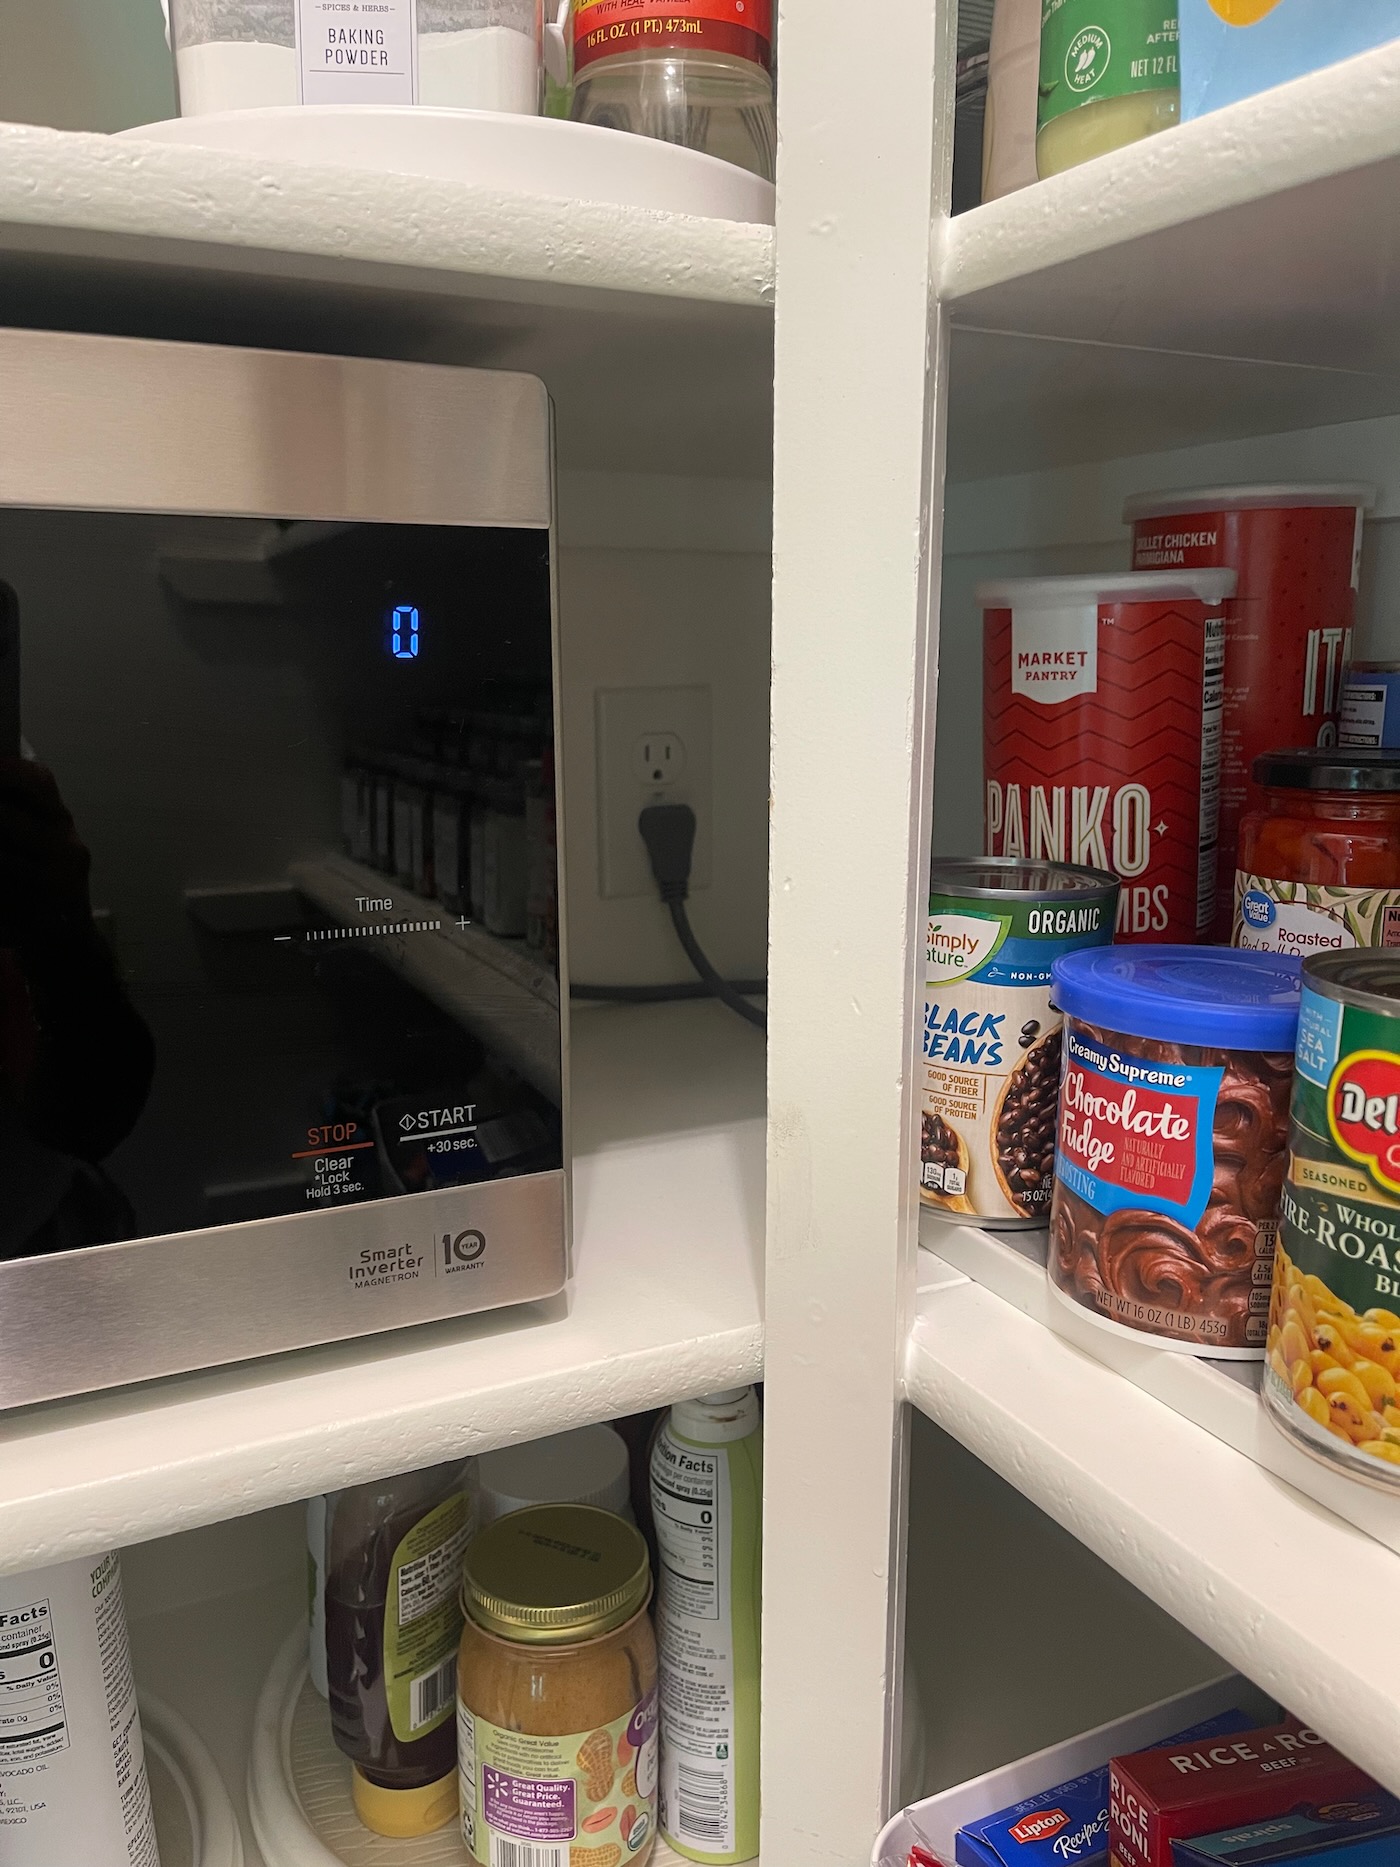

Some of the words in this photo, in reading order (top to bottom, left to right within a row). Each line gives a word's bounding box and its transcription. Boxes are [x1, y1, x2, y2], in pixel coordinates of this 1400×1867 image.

[597, 1, 617, 14] WITH
[587, 33, 597, 48] 16
[610, 24, 629, 40] OZ.
[631, 22, 641, 37] (1
[643, 18, 663, 34] PT.)
[665, 18, 703, 34] 473mL
[1163, 19, 1181, 30] RE
[328, 28, 384, 45] BAKING
[1071, 33, 1104, 58] MEDIUM
[325, 48, 389, 66] POWDER
[1130, 58, 1149, 78] NET
[1152, 56, 1164, 75] 12
[1166, 55, 1178, 73] FL
[1073, 68, 1096, 85] HEAT
[1164, 531, 1218, 549] CHICKEN
[392, 605, 419, 659] 0
[1018, 651, 1088, 669] MARKET
[1025, 671, 1078, 681] PANTRY
[987, 779, 1151, 878] PANKO
[355, 896, 393, 913] Time
[1244, 896, 1270, 915] Great
[1028, 907, 1101, 934] ORGANIC
[1247, 911, 1270, 923] Value
[1278, 928, 1343, 949] Roasted
[1010, 972, 1053, 981] NON-GM
[1301, 1028, 1325, 1054] SEA
[1069, 1035, 1109, 1072] Creamy
[1108, 1053, 1186, 1088] Supreme
[1298, 1043, 1328, 1071] SALT
[928, 1069, 947, 1081] GOOD
[949, 1074, 979, 1087] SOURCE
[942, 1083, 953, 1093] OF
[954, 1084, 978, 1097] FIBER
[929, 1094, 947, 1106] GOOD
[948, 1098, 977, 1111] SOURCE
[1065, 1071, 1191, 1141] Chocolate
[1339, 1081, 1399, 1136] Del
[417, 1104, 477, 1129] START
[934, 1105, 944, 1114] OF
[944, 1108, 977, 1120] PROTEIN
[308, 1122, 358, 1146] STOP
[1062, 1110, 1115, 1172] Fudge
[427, 1140, 451, 1154] +30
[452, 1137, 479, 1151] sec.
[1123, 1136, 1166, 1160] NATURALLY
[314, 1156, 355, 1174] Clear
[1121, 1151, 1135, 1168] AND
[1135, 1157, 1187, 1180] ARTIFICIALLY
[1119, 1165, 1156, 1189] FLAVORED
[1302, 1167, 1368, 1193] SEASONED
[306, 1187, 332, 1200] Hold
[333, 1184, 341, 1196] 3
[342, 1181, 365, 1194] sec.
[1021, 1190, 1033, 1202] 15
[1335, 1202, 1400, 1242] WHOL
[359, 1243, 413, 1264] Smart
[441, 1229, 486, 1265] 10
[460, 1242, 478, 1250] YEAR
[348, 1255, 425, 1280] Inverter
[444, 1261, 486, 1275] WARRANTY
[354, 1270, 420, 1290] MAGNETRON
[1096, 1289, 1113, 1308] NET
[1116, 1298, 1131, 1315] WT
[1134, 1304, 1144, 1320] 16
[1147, 1308, 1162, 1324] OZ
[1165, 1311, 1174, 1327] (1
[1177, 1317, 1196, 1332] LB)
[1199, 1319, 1227, 1337] 453g
[678, 1455, 714, 1473] Facts
[683, 1475, 713, 1486] container
[700, 1510, 713, 1525] 0
[90, 1555, 110, 1585] YOUR
[0, 1606, 48, 1628] Facts
[1, 1624, 43, 1642] container
[12, 1639, 30, 1649] spray
[39, 1651, 55, 1669] 0
[16, 1681, 35, 1690] Daily
[46, 1681, 59, 1691] 0%
[47, 1692, 61, 1702] 0%
[49, 1702, 63, 1713] 0%
[17, 1715, 28, 1723] 0g
[492, 1729, 517, 1743] Organic
[518, 1737, 537, 1747] Great
[539, 1740, 559, 1748] Value
[1168, 1742, 1260, 1774] RICE
[1262, 1741, 1277, 1752] A
[1274, 1728, 1327, 1752] RO
[1259, 1756, 1298, 1773] BEEF
[512, 1780, 535, 1791] Great
[536, 1783, 571, 1793] Quality.
[512, 1788, 535, 1800] Great
[536, 1791, 561, 1801] Price.
[1014, 1799, 1037, 1814] BEST
[1053, 1781, 1080, 1796] USED
[1080, 1776, 1092, 1786] BY
[30, 1801, 47, 1812] USA
[512, 1796, 565, 1809] Guaranteed.
[1110, 1771, 1149, 1833] RICE
[1014, 1811, 1066, 1840] Lipton
[1053, 1822, 1100, 1860] Recipe
[1118, 1842, 1137, 1866] BEEF
